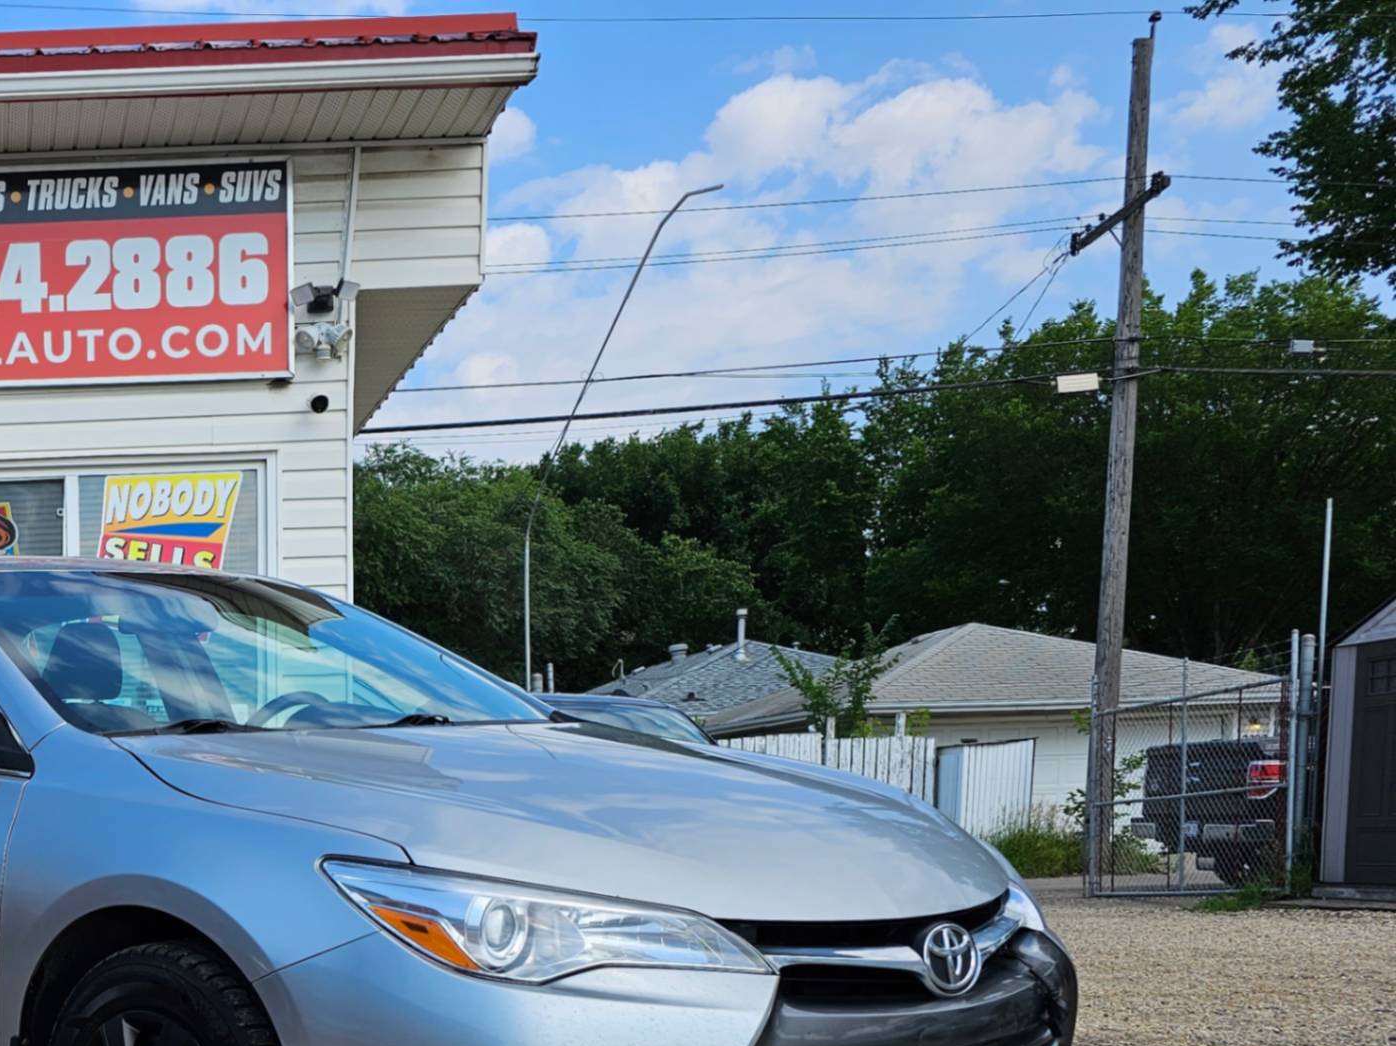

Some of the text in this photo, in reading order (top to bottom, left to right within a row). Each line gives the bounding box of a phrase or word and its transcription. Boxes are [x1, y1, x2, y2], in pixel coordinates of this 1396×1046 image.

[27, 176, 119, 211] TRUCKS
[138, 173, 201, 206] VANS
[219, 169, 283, 202] SUVS
[106, 479, 237, 525] NOBODY
